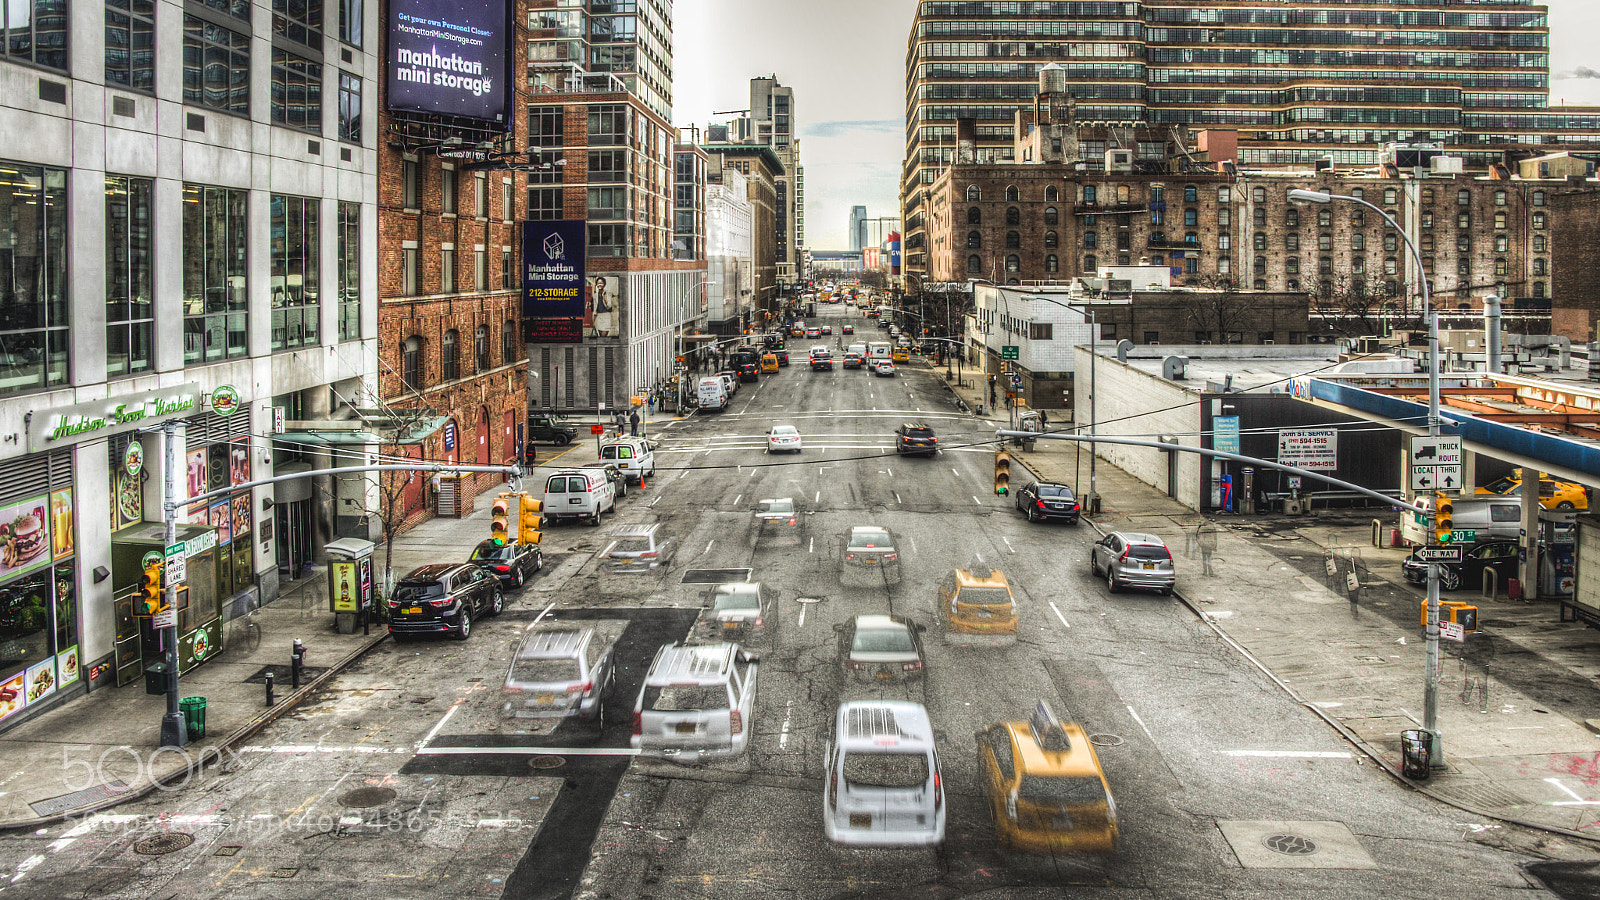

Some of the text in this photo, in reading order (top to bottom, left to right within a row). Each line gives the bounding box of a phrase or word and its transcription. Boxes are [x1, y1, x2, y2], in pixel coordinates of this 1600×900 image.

[398, 12, 410, 21] Get
[411, 16, 427, 24] your
[427, 19, 442, 27] own
[442, 21, 470, 33] Personal
[397, 23, 483, 46] ManhattanMiniStorage.com
[397, 44, 482, 75] manhattan
[397, 65, 491, 96] mini storage
[528, 262, 574, 273] Manhattan
[528, 272, 579, 282] Mini Storage
[529, 288, 579, 297] 212-STORAGE
[1289, 378, 1309, 399] Mobil
[53, 397, 194, 441] Hudson Food Market
[1439, 454, 1459, 462] ROUTE
[1413, 466, 1434, 474] LOCAL
[1452, 531, 1465, 541] 30
[1421, 550, 1455, 558] ONE WAY
[168, 564, 185, 576] SHARED
[171, 573, 182, 583] LANE
